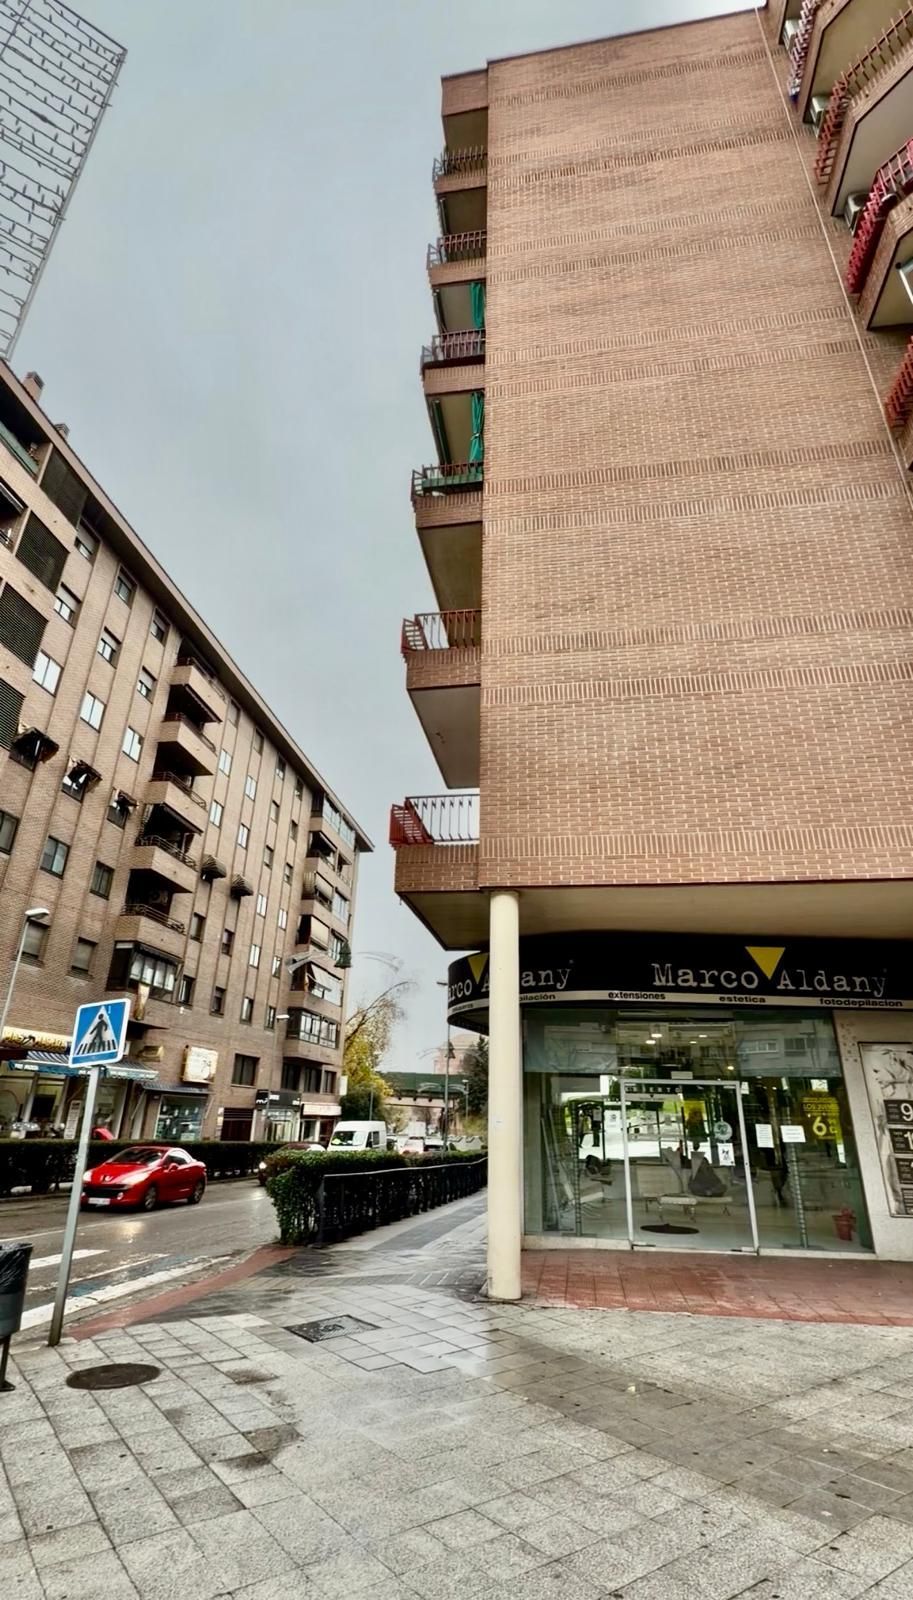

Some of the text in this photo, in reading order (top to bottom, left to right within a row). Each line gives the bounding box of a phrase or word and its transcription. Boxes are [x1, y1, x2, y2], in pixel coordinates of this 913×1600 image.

[448, 979, 473, 1003] arco
[651, 962, 759, 989] Marco
[776, 968, 888, 997] Aldany
[608, 990, 666, 1001] extensiones
[719, 994, 766, 1004] estetica
[819, 997, 903, 1009] fotodepilacion
